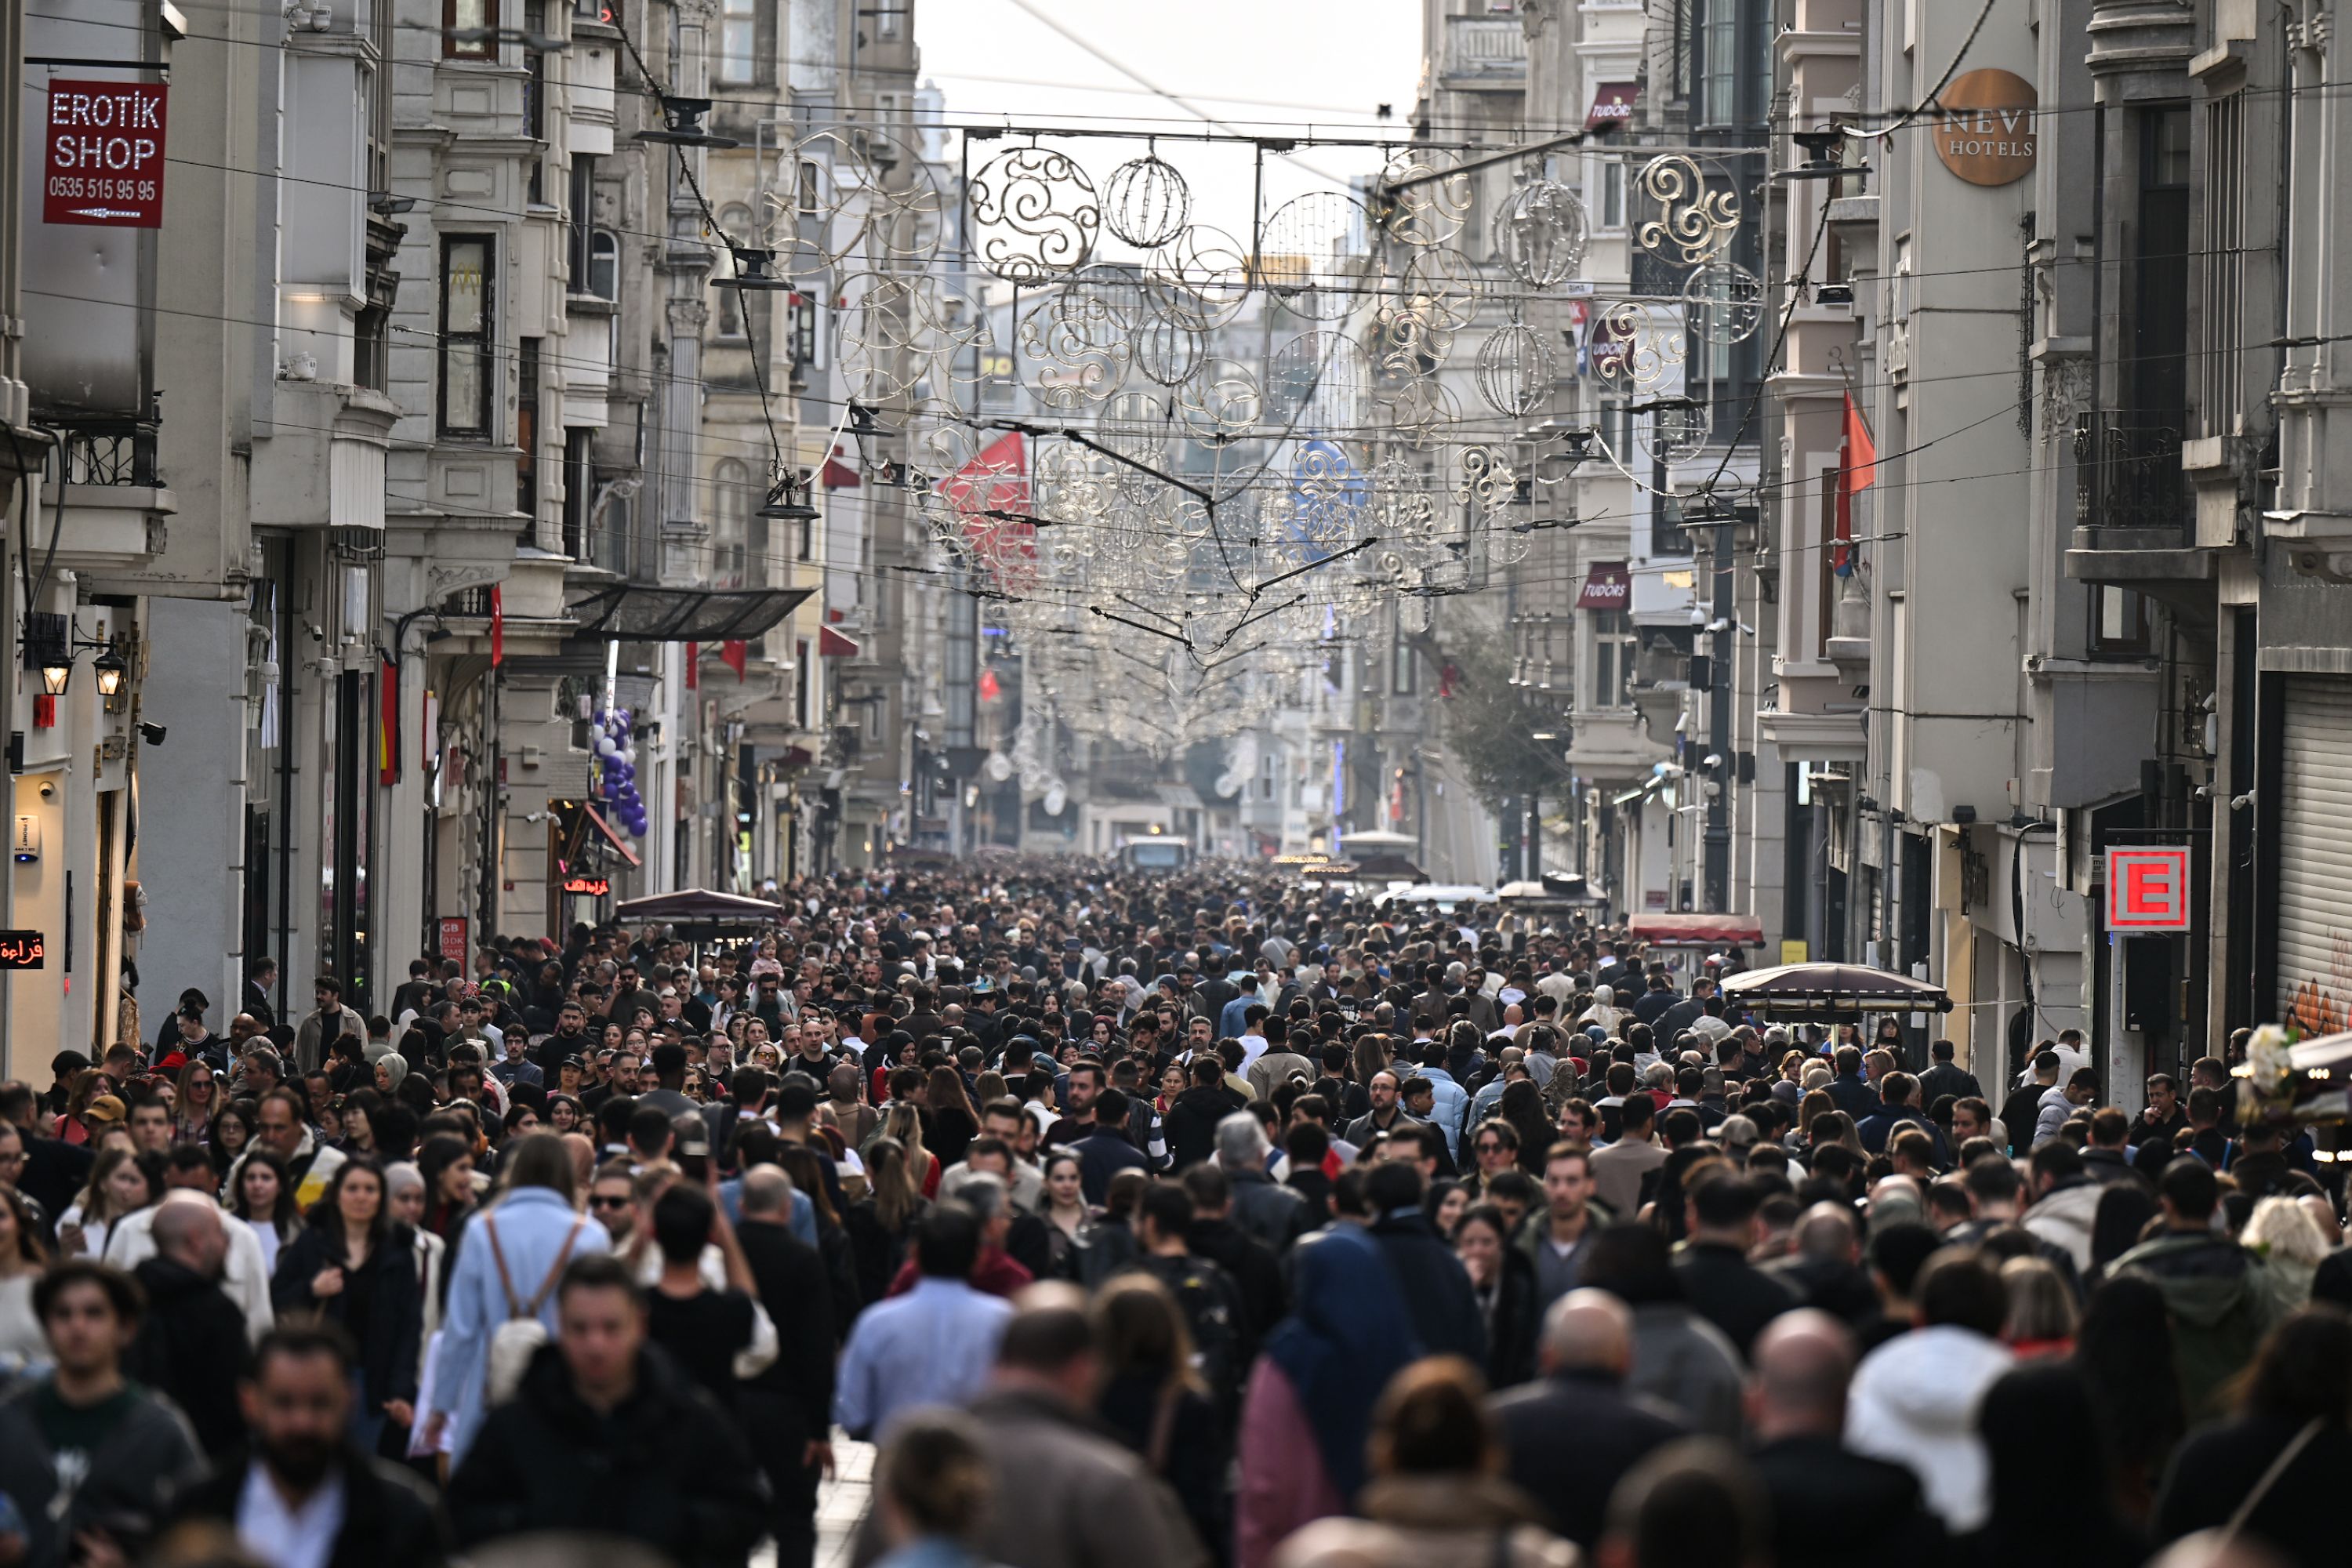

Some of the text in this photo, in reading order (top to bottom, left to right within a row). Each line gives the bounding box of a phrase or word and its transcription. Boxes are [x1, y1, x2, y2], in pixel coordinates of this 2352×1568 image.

[53, 90, 161, 129] EROTİK
[54, 135, 156, 170] SHOP
[1949, 140, 2033, 157] HOTELS
[49, 176, 155, 201] 0535 515 95 95
[1585, 584, 1626, 597] TUDORS
[2128, 864, 2169, 913] E
[1, 938, 43, 964] قراءة
